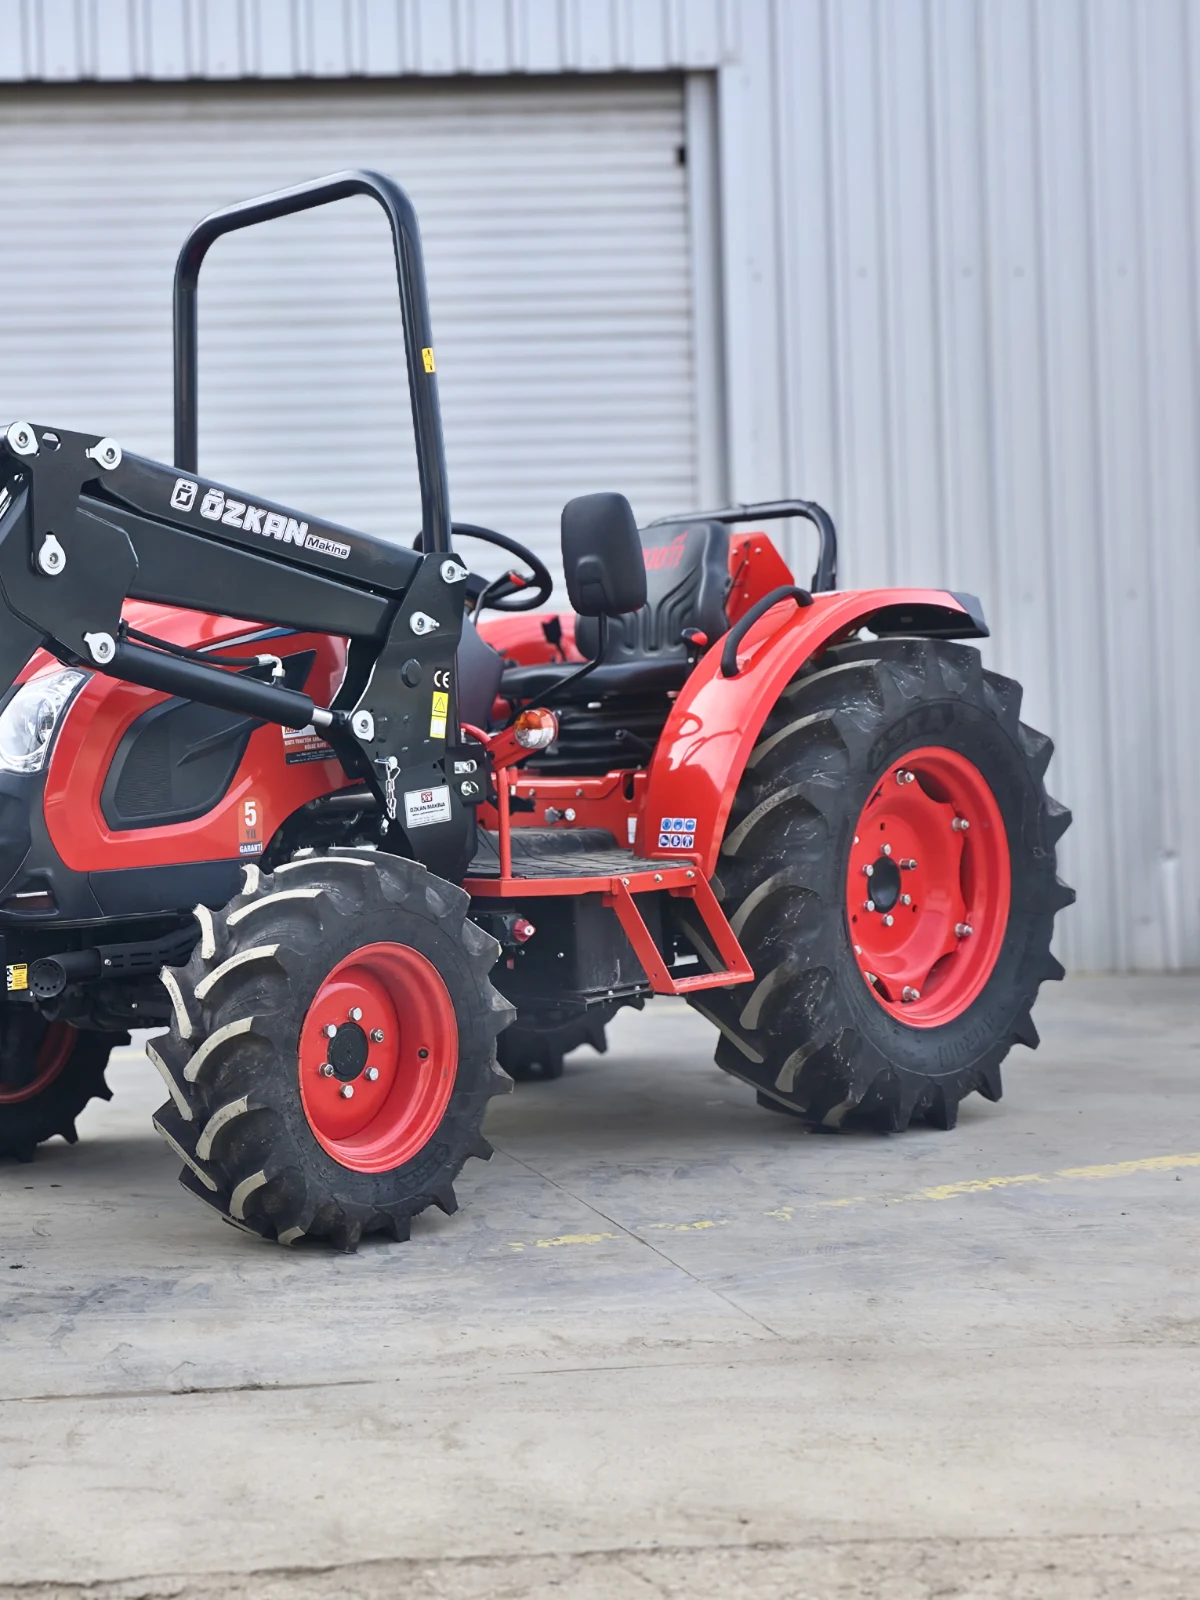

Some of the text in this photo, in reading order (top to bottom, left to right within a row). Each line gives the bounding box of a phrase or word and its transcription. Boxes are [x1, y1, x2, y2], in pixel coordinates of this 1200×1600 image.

[200, 487, 309, 546] ÖZKAN
[307, 537, 348, 557] Makina
[434, 670, 450, 688] CE
[244, 801, 257, 827] 5
